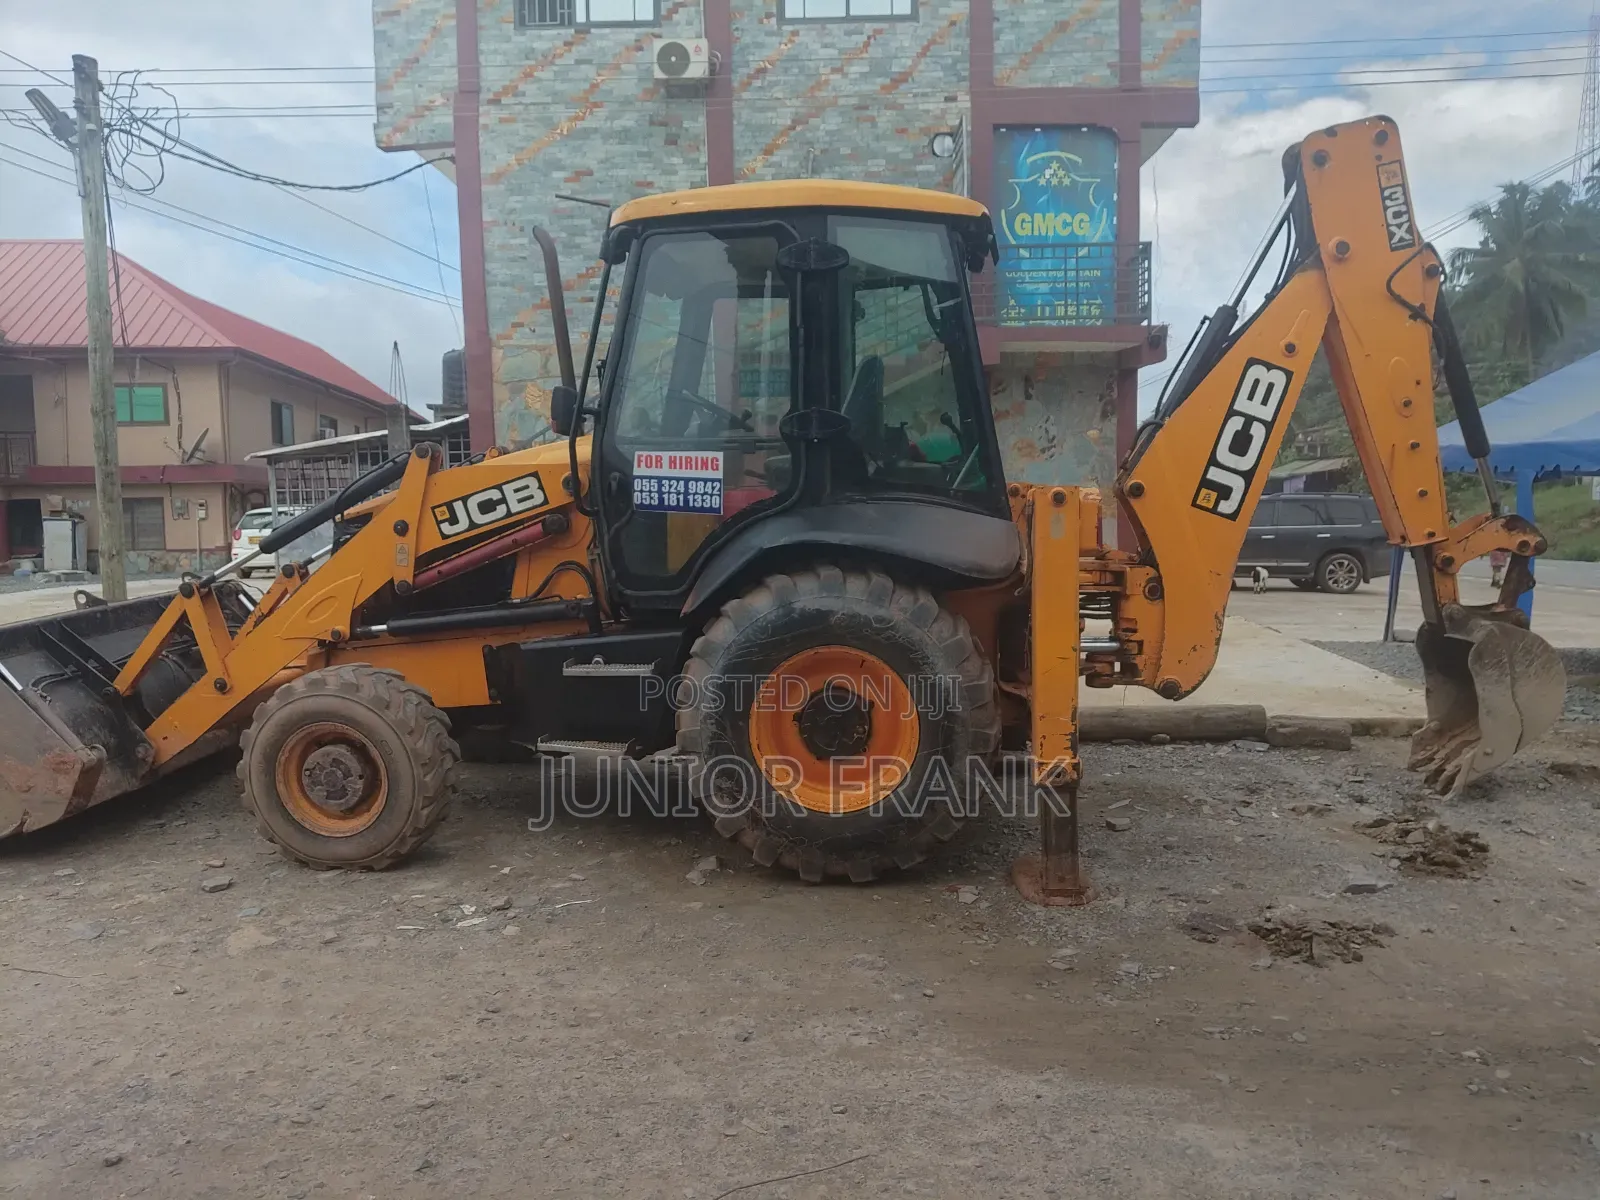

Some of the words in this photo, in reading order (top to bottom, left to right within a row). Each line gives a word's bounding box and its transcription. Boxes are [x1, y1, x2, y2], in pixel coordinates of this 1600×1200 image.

[1014, 212, 1091, 237] GMCG
[1383, 186, 1413, 245] 3CX
[1206, 364, 1287, 514] JCB
[637, 454, 663, 469] FOR
[668, 455, 720, 471] HIRING
[633, 479, 658, 491] 055
[661, 480, 685, 493] 324
[688, 480, 721, 495] 9842
[439, 476, 545, 535] JCB
[633, 492, 659, 505] 053
[662, 493, 684, 507] 181
[687, 494, 720, 508] 1330
